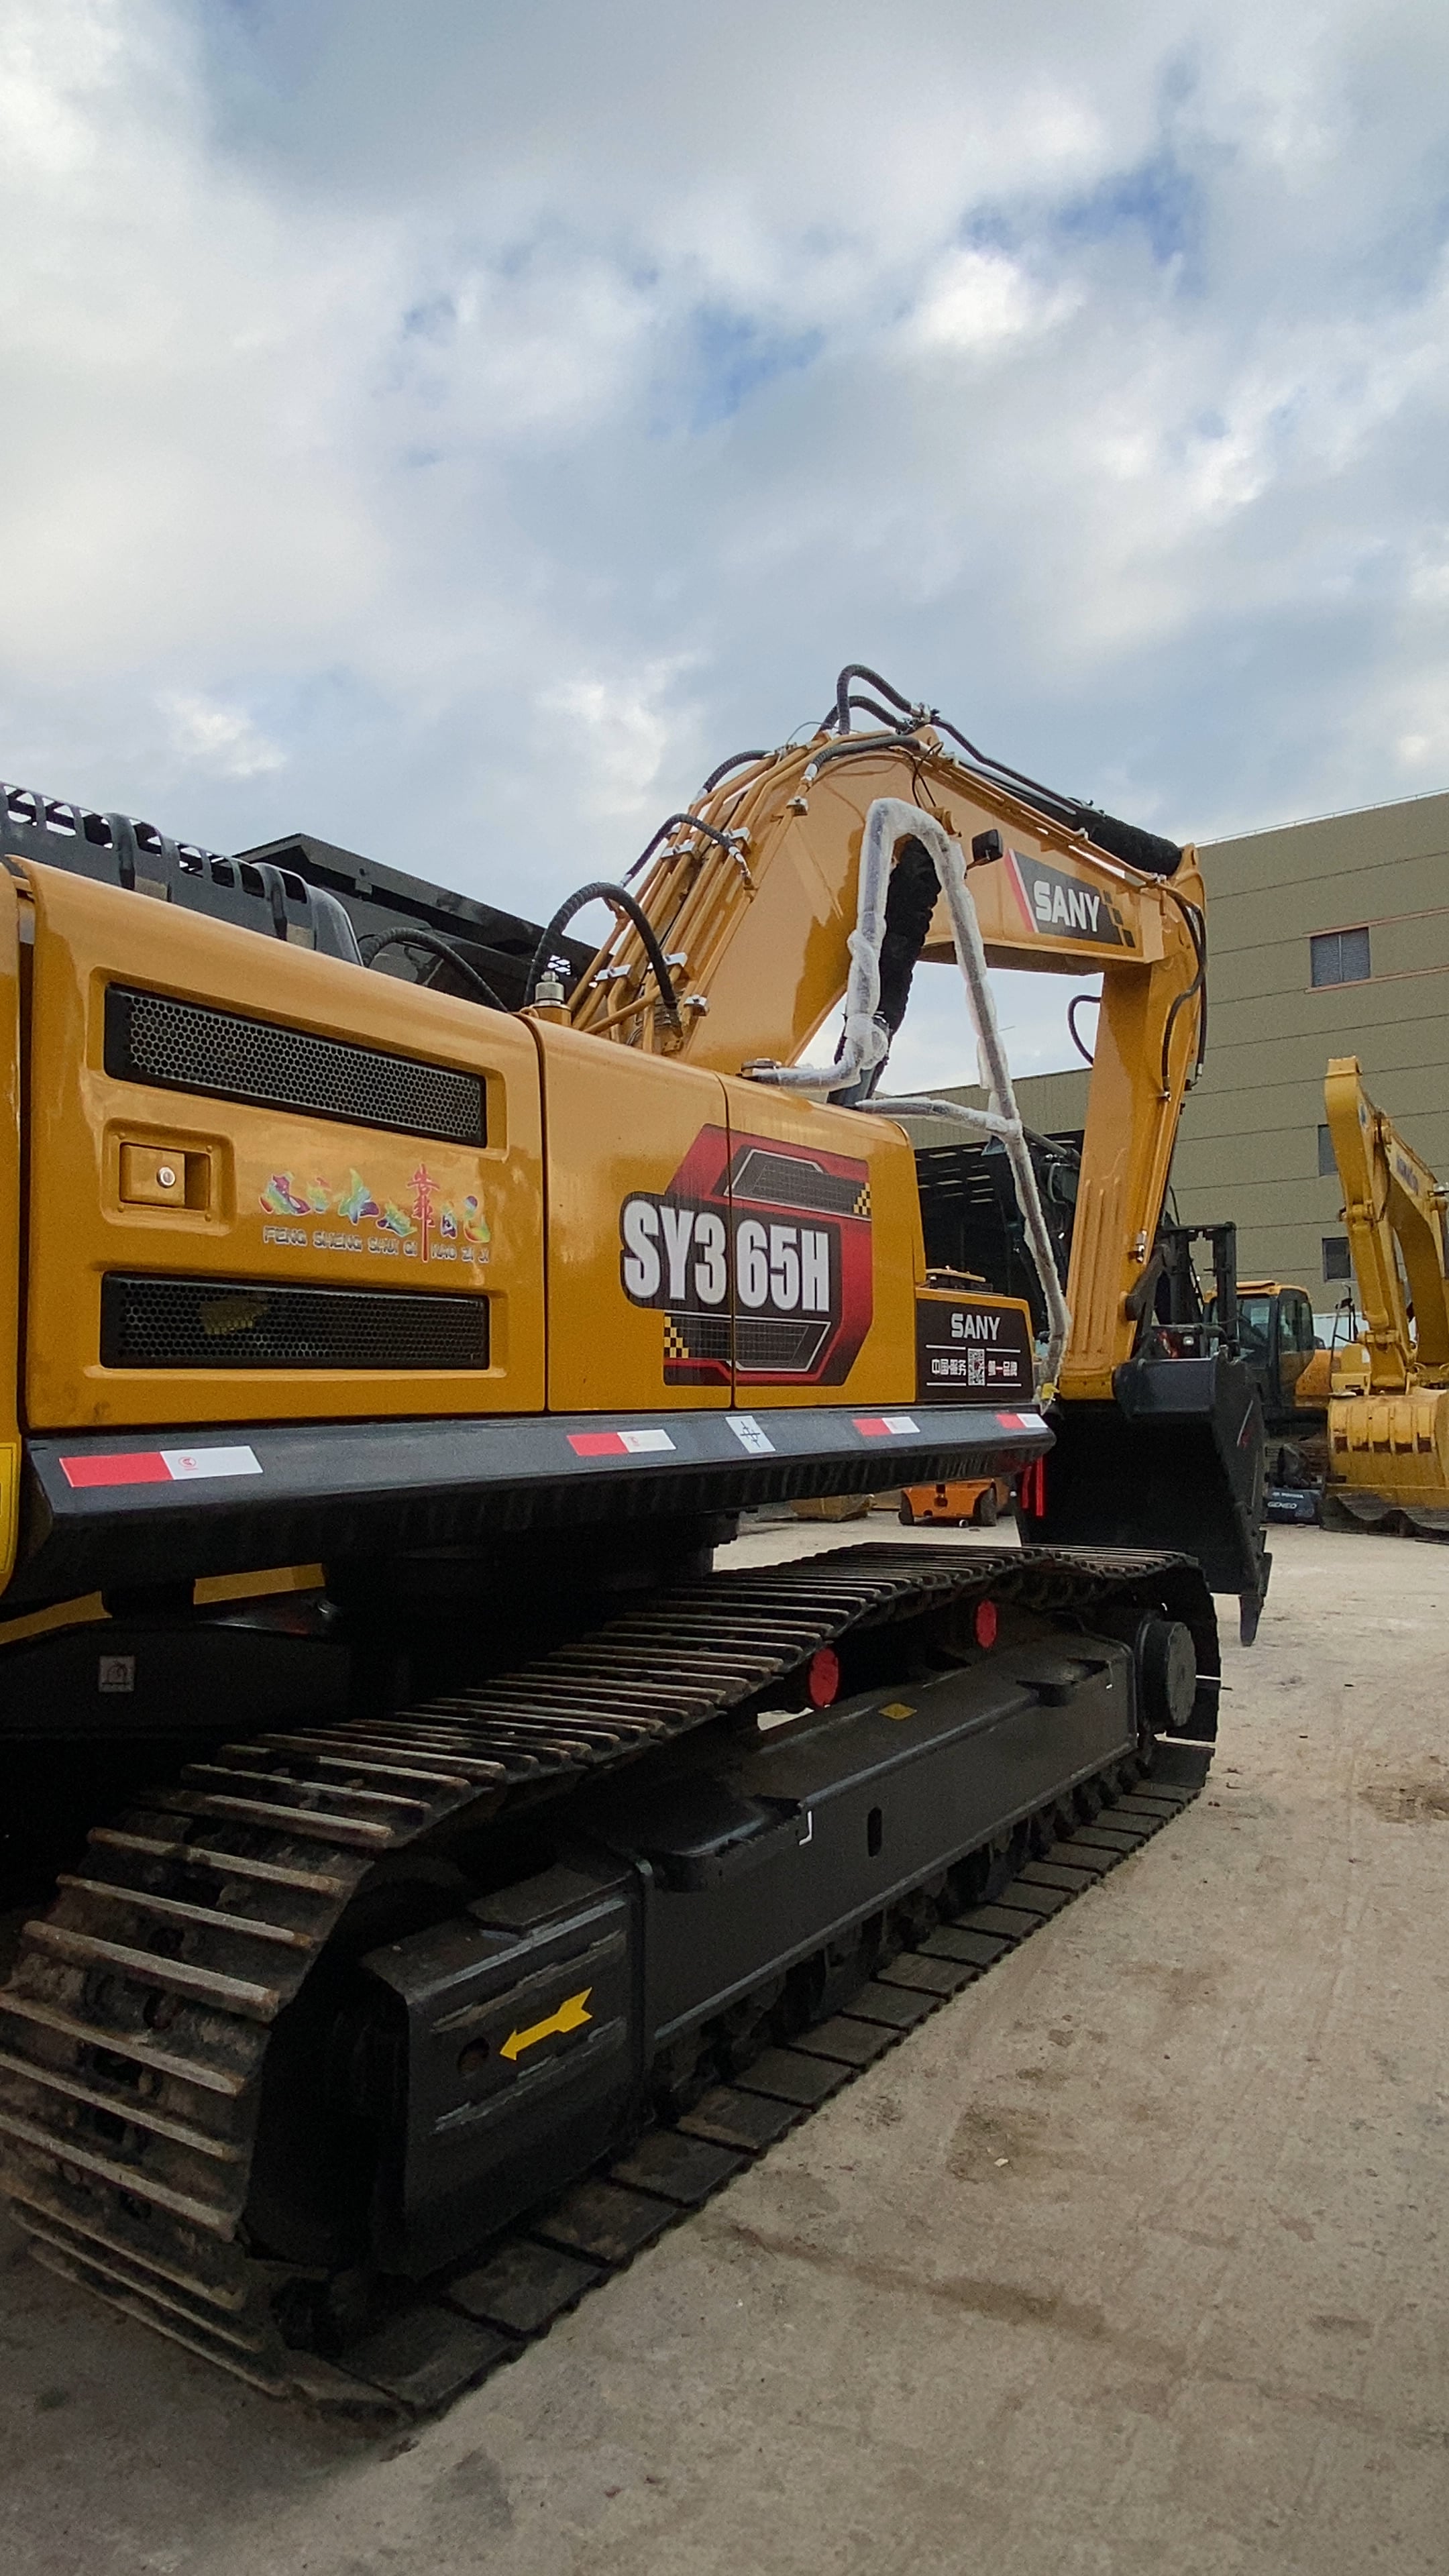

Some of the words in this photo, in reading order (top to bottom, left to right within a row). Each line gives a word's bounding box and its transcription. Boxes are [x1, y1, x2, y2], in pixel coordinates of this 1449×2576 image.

[1034, 881, 1099, 932] SANY
[264, 1226, 307, 1246] FENG
[313, 1231, 363, 1252] SHENG
[368, 1237, 399, 1256] SHUI
[624, 1199, 829, 1311] SY365H
[951, 1313, 1000, 1340] SANY
